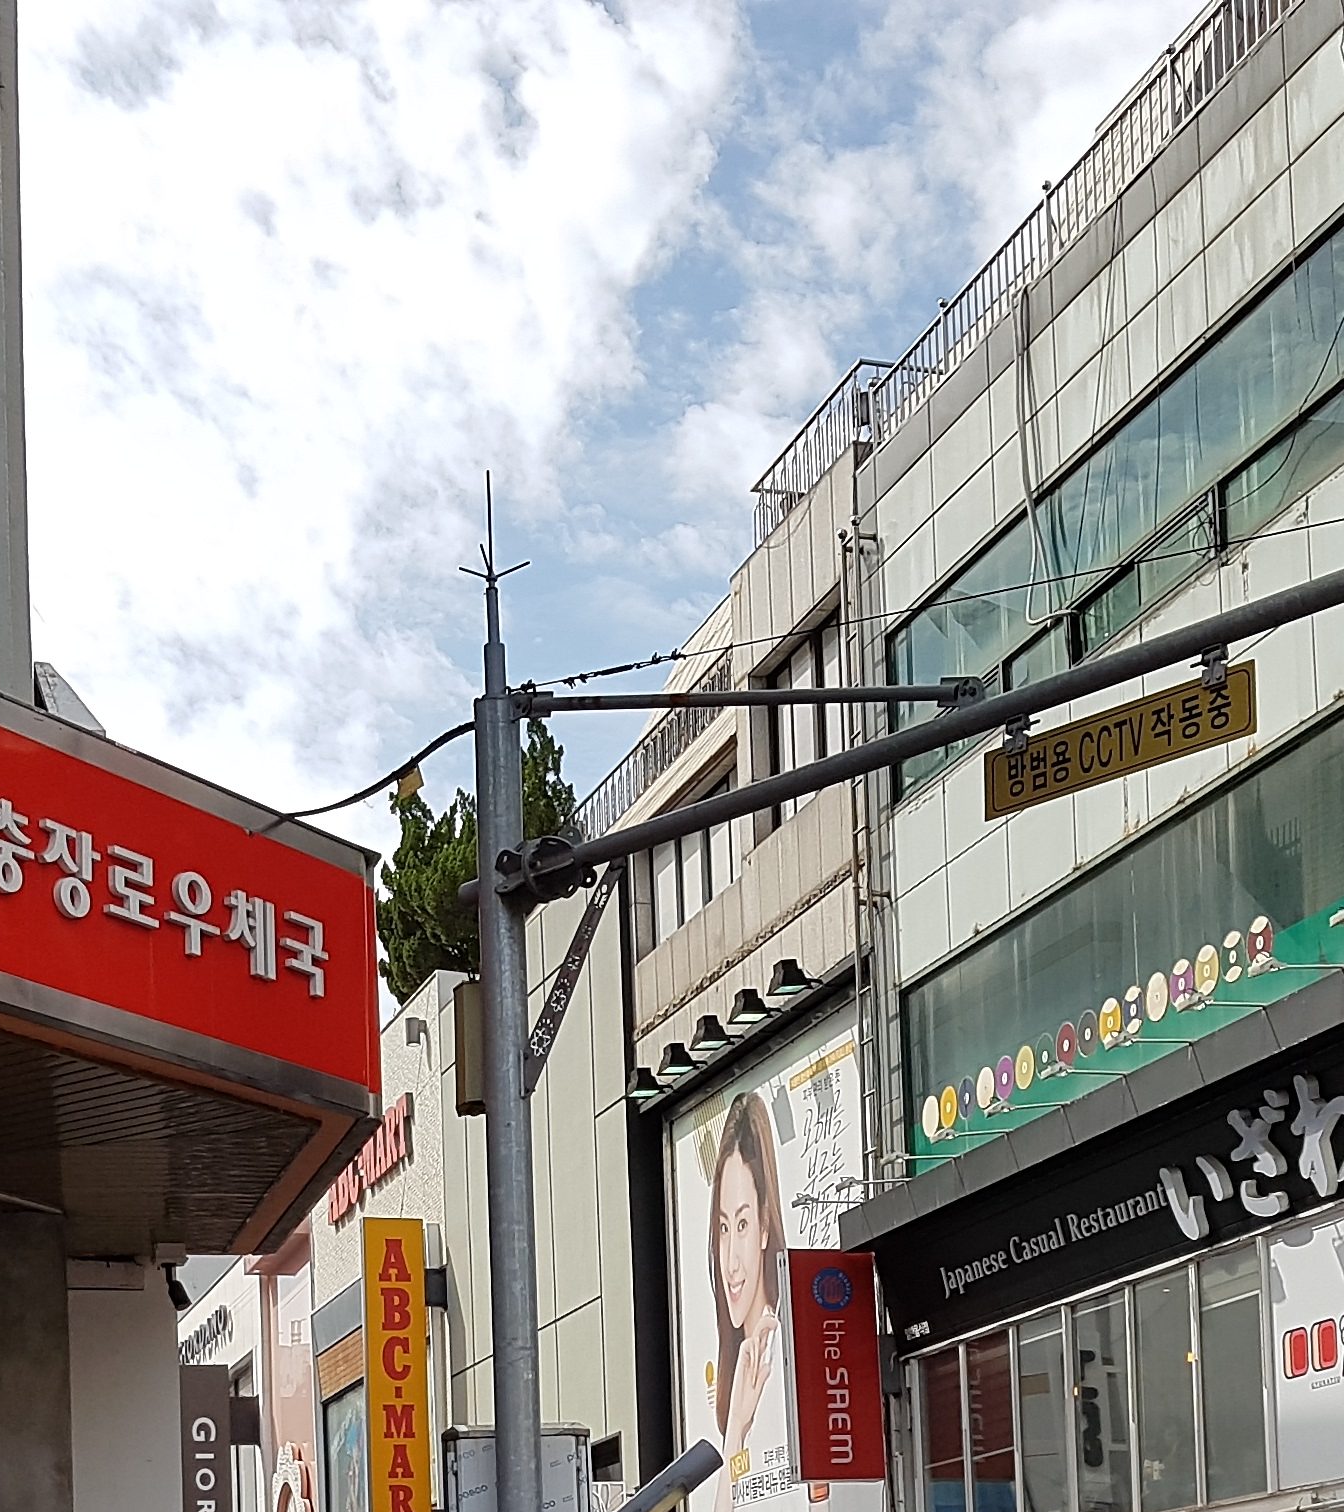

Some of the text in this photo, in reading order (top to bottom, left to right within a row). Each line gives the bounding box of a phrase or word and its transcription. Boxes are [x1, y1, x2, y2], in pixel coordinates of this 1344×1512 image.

[1007, 684, 1232, 798] 방범용 CCTV 작동중
[939, 1183, 1168, 1299] Japanese Casual Restaurant
[823, 1319, 846, 1360] the
[732, 1450, 749, 1478] NEW
[824, 1366, 854, 1464] SAEM
